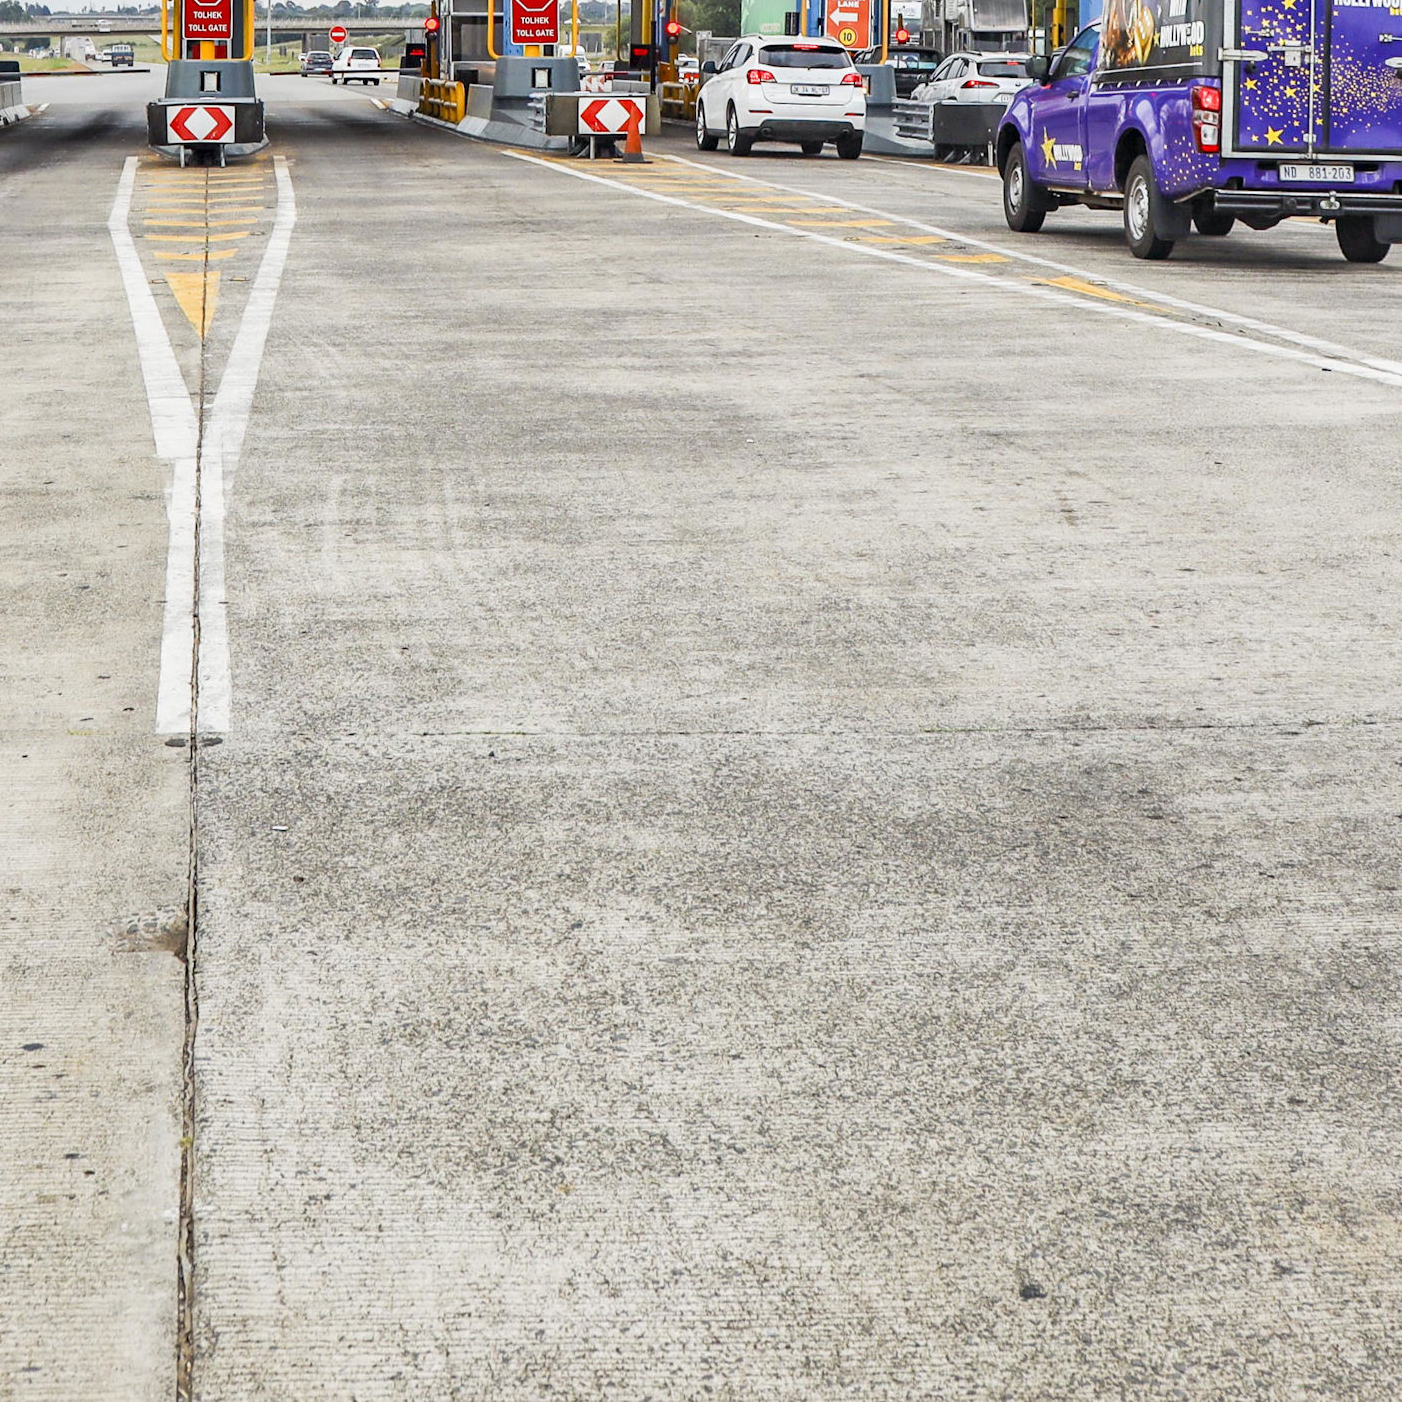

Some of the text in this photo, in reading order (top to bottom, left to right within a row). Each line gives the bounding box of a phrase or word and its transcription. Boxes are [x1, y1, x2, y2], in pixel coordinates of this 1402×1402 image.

[838, 0, 859, 8] LANE
[193, 10, 223, 19] TOLHEK
[520, 16, 550, 25] TOLHEK
[188, 23, 227, 32] TOLL GATE
[516, 29, 555, 37] TOLL GATE
[843, 32, 853, 42] 10
[1284, 166, 1351, 179] ND 881-203
